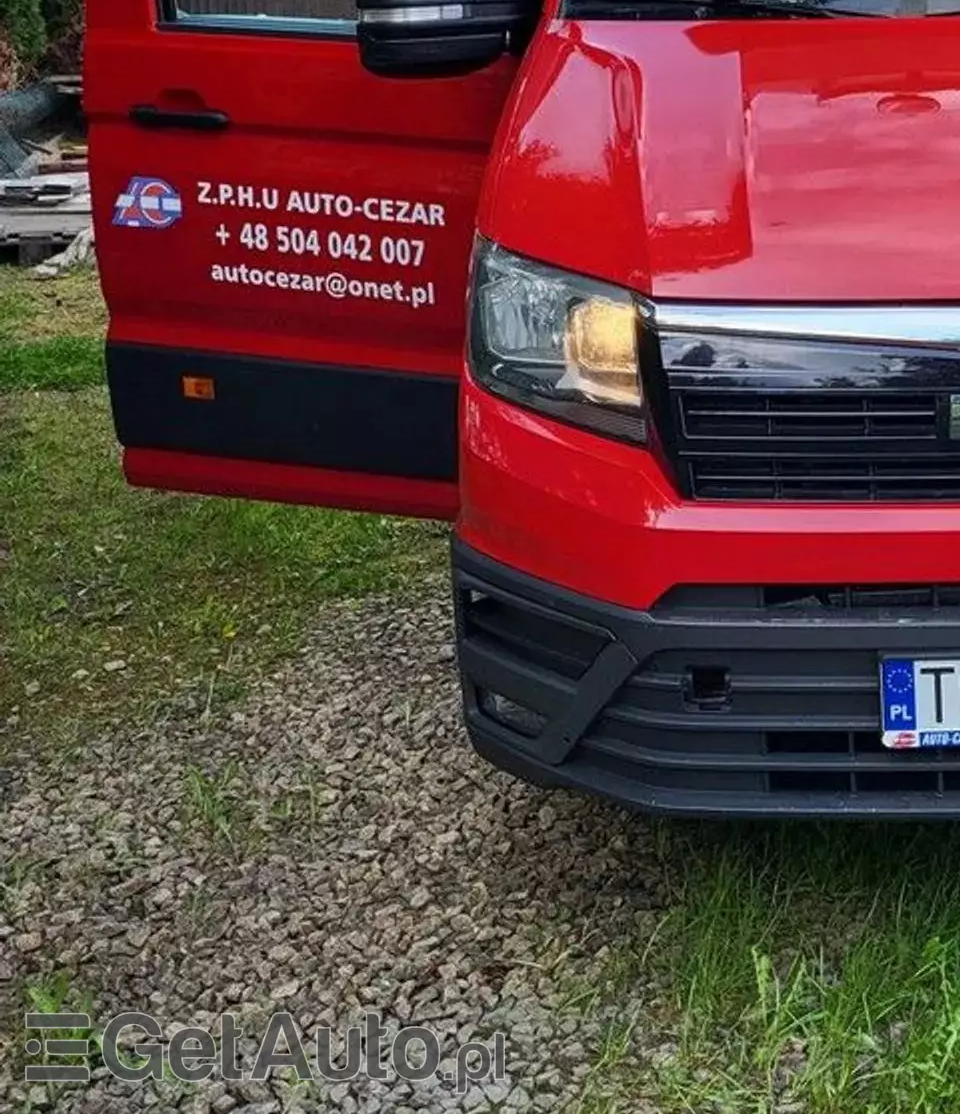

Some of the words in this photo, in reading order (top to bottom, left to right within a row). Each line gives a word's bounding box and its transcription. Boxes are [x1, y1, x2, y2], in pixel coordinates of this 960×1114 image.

[197, 181, 278, 211] Z.P.H.U
[286, 189, 445, 227] AUTO-CEZAR
[240, 222, 269, 251] 48
[276, 226, 320, 256] 504
[327, 230, 372, 263] 042
[380, 236, 425, 267] 007
[211, 263, 435, 308] autocezar@onet.pl
[889, 705, 914, 722] PL
